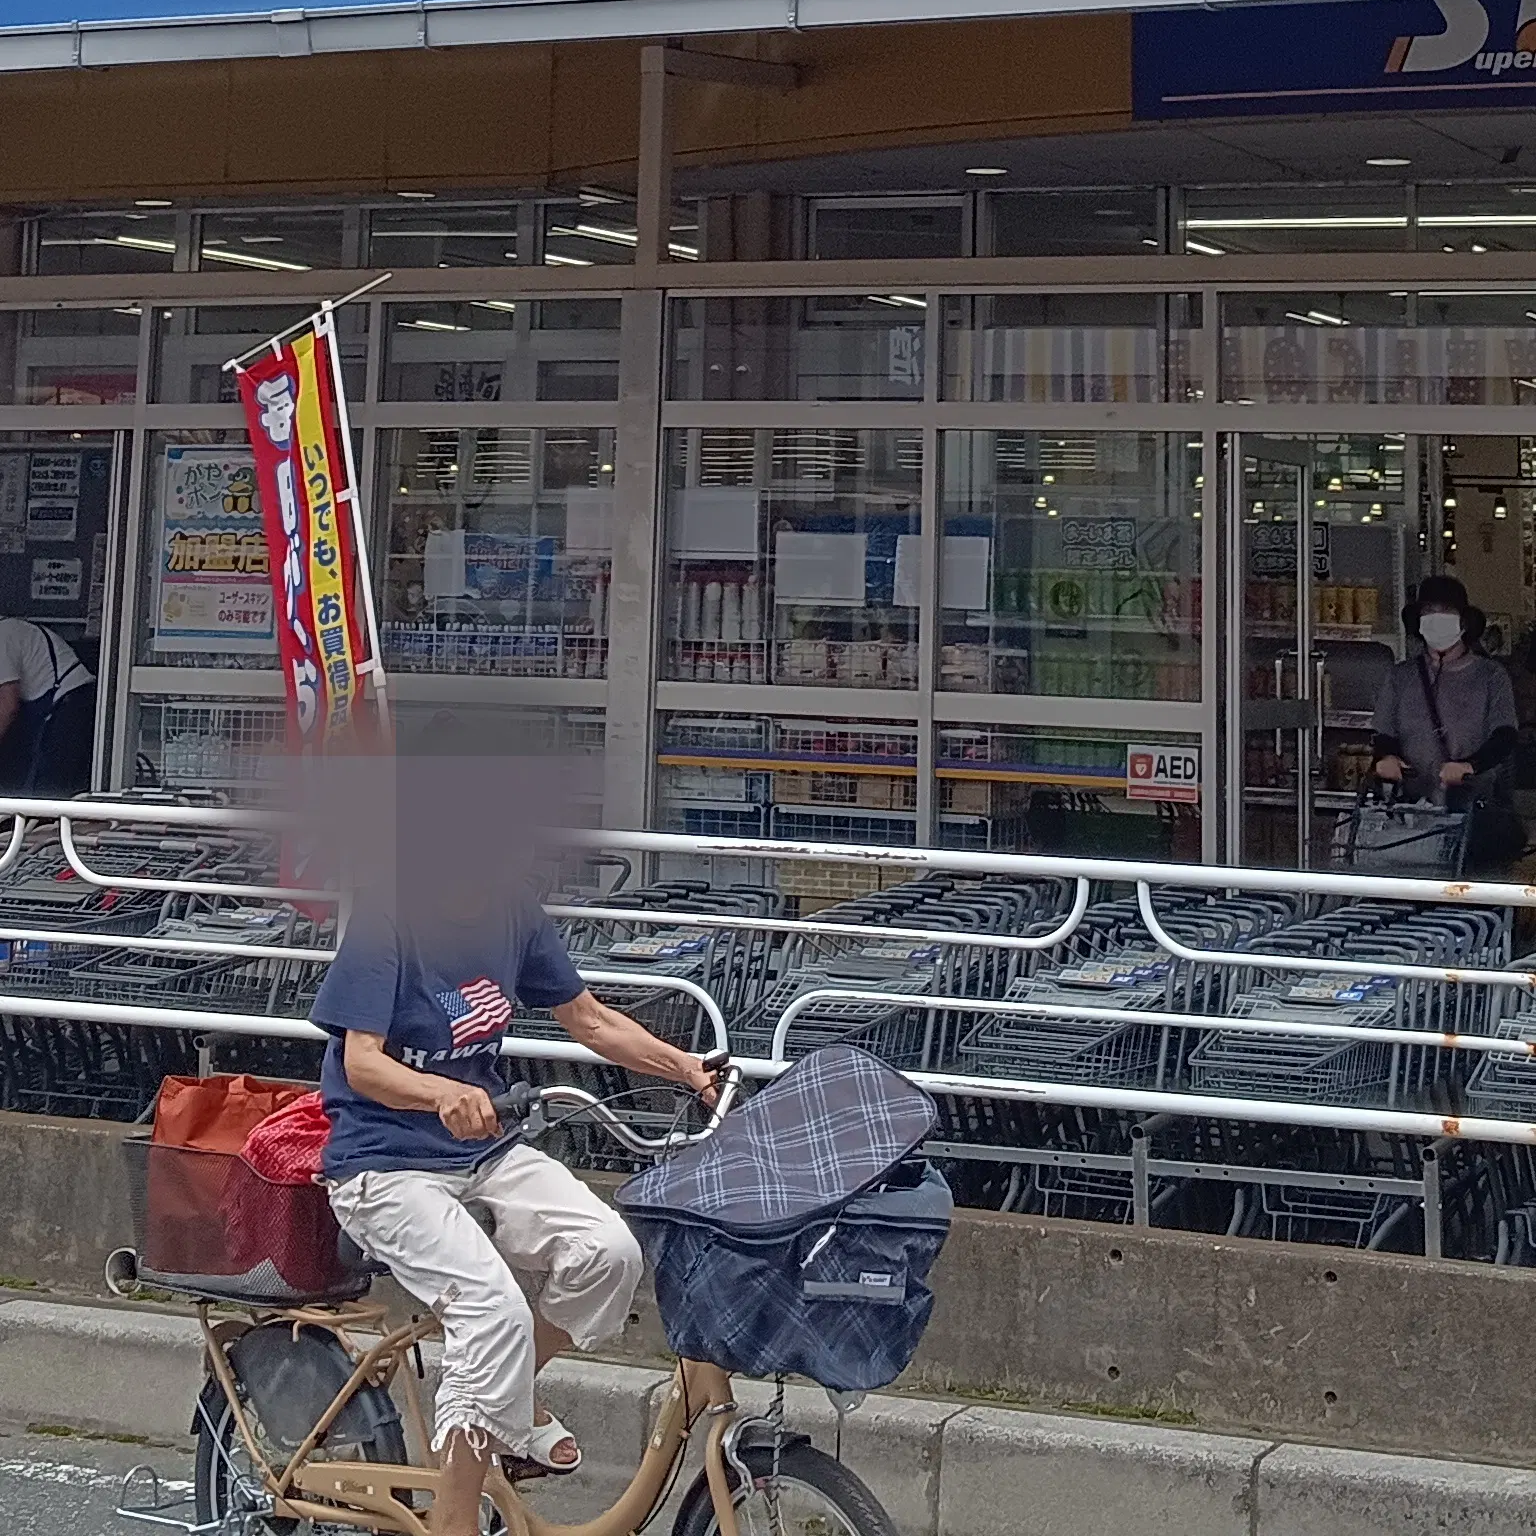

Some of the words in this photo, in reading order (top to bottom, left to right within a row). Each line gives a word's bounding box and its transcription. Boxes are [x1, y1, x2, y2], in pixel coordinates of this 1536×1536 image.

[168, 531, 270, 573] 加盟店
[217, 609, 267, 625] のみ可能です
[1154, 754, 1196, 780] AED
